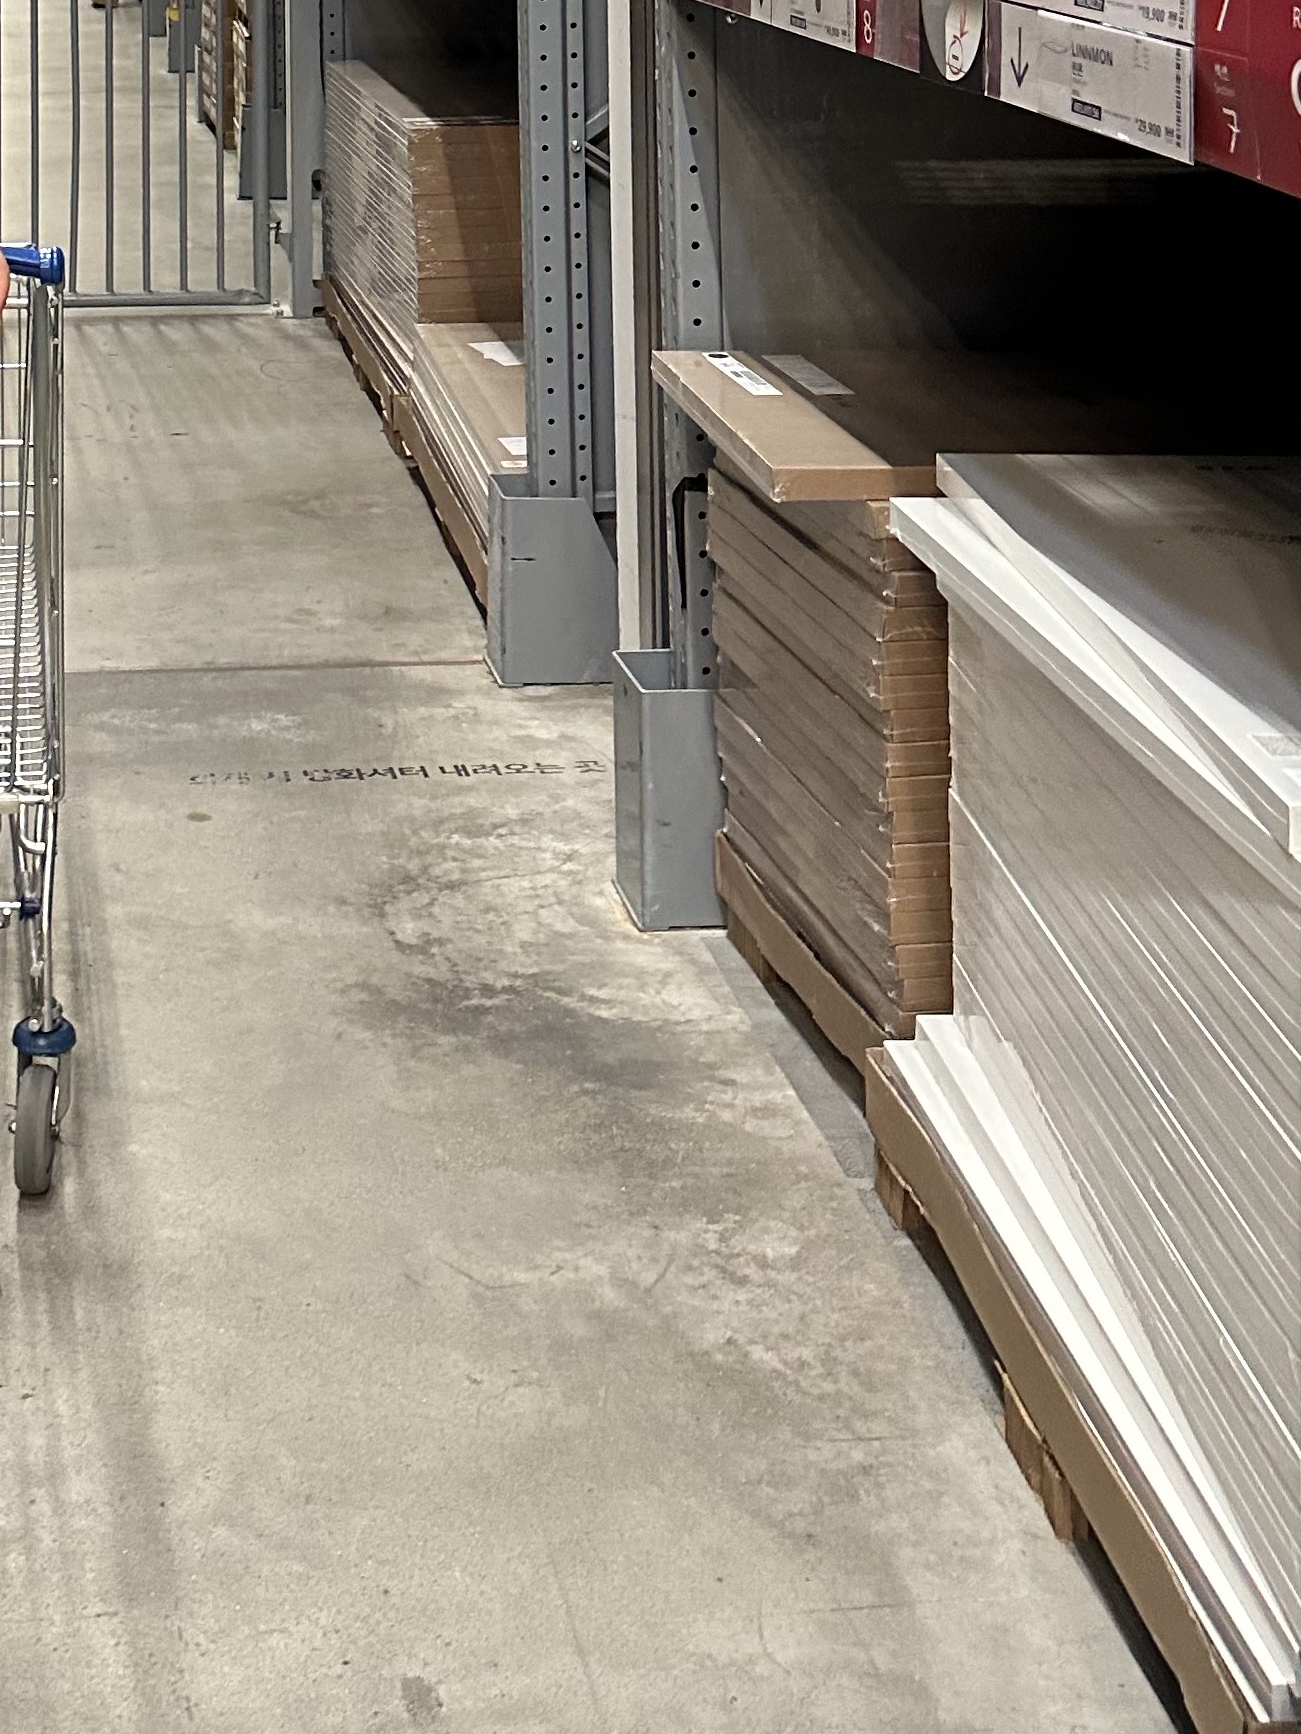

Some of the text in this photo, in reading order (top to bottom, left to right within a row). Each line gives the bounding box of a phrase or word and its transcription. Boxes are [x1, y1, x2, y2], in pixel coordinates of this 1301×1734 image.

[863, 9, 873, 44] 8
[1070, 41, 1115, 67] LINNMON
[1221, 106, 1241, 154] 7
[438, 761, 564, 778] 내려오는
